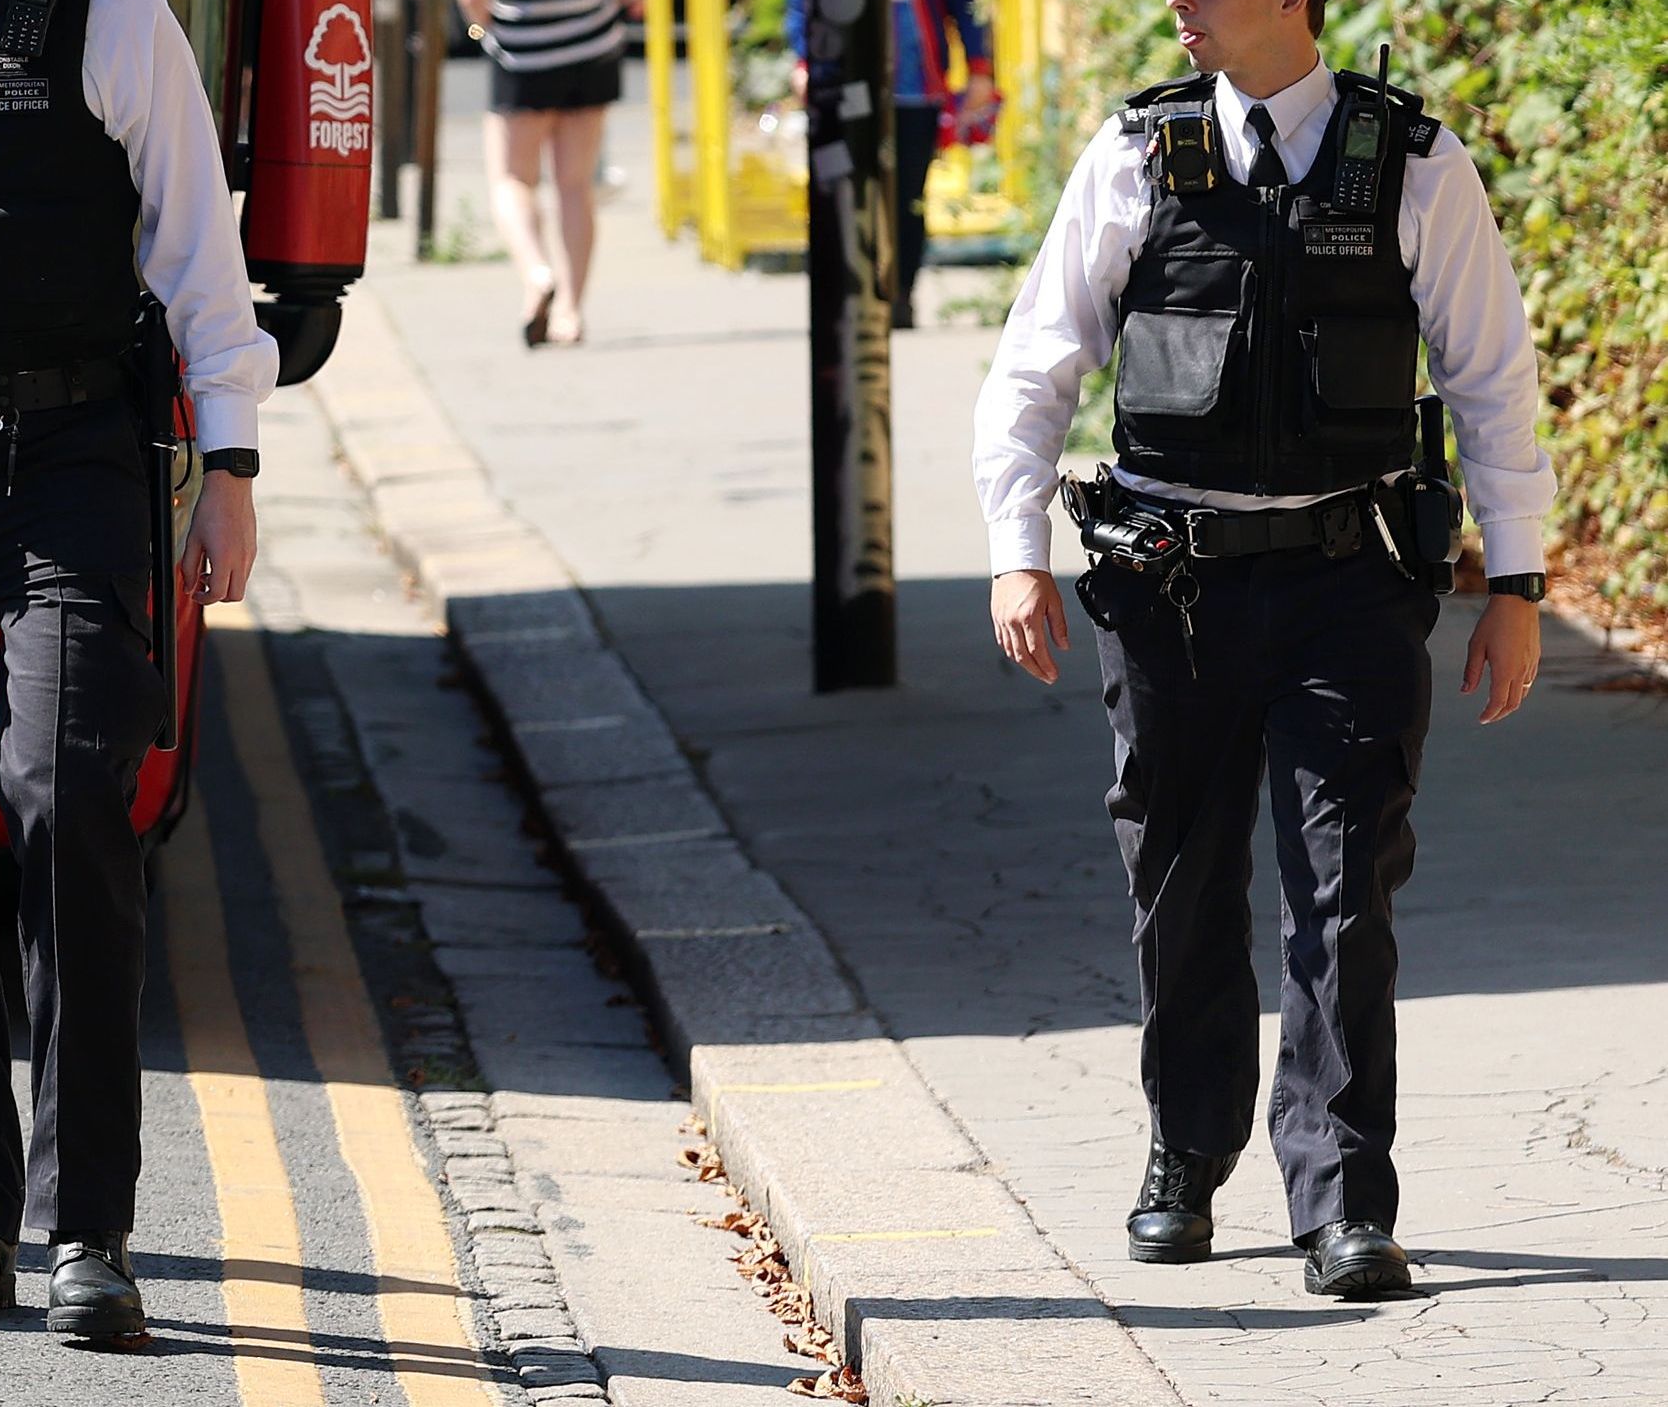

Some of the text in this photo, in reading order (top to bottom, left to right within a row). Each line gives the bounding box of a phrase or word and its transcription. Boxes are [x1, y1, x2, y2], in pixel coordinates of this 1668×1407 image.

[12, 100, 49, 110] OFFICER
[1305, 245, 1373, 256] POLICE OFFICER
